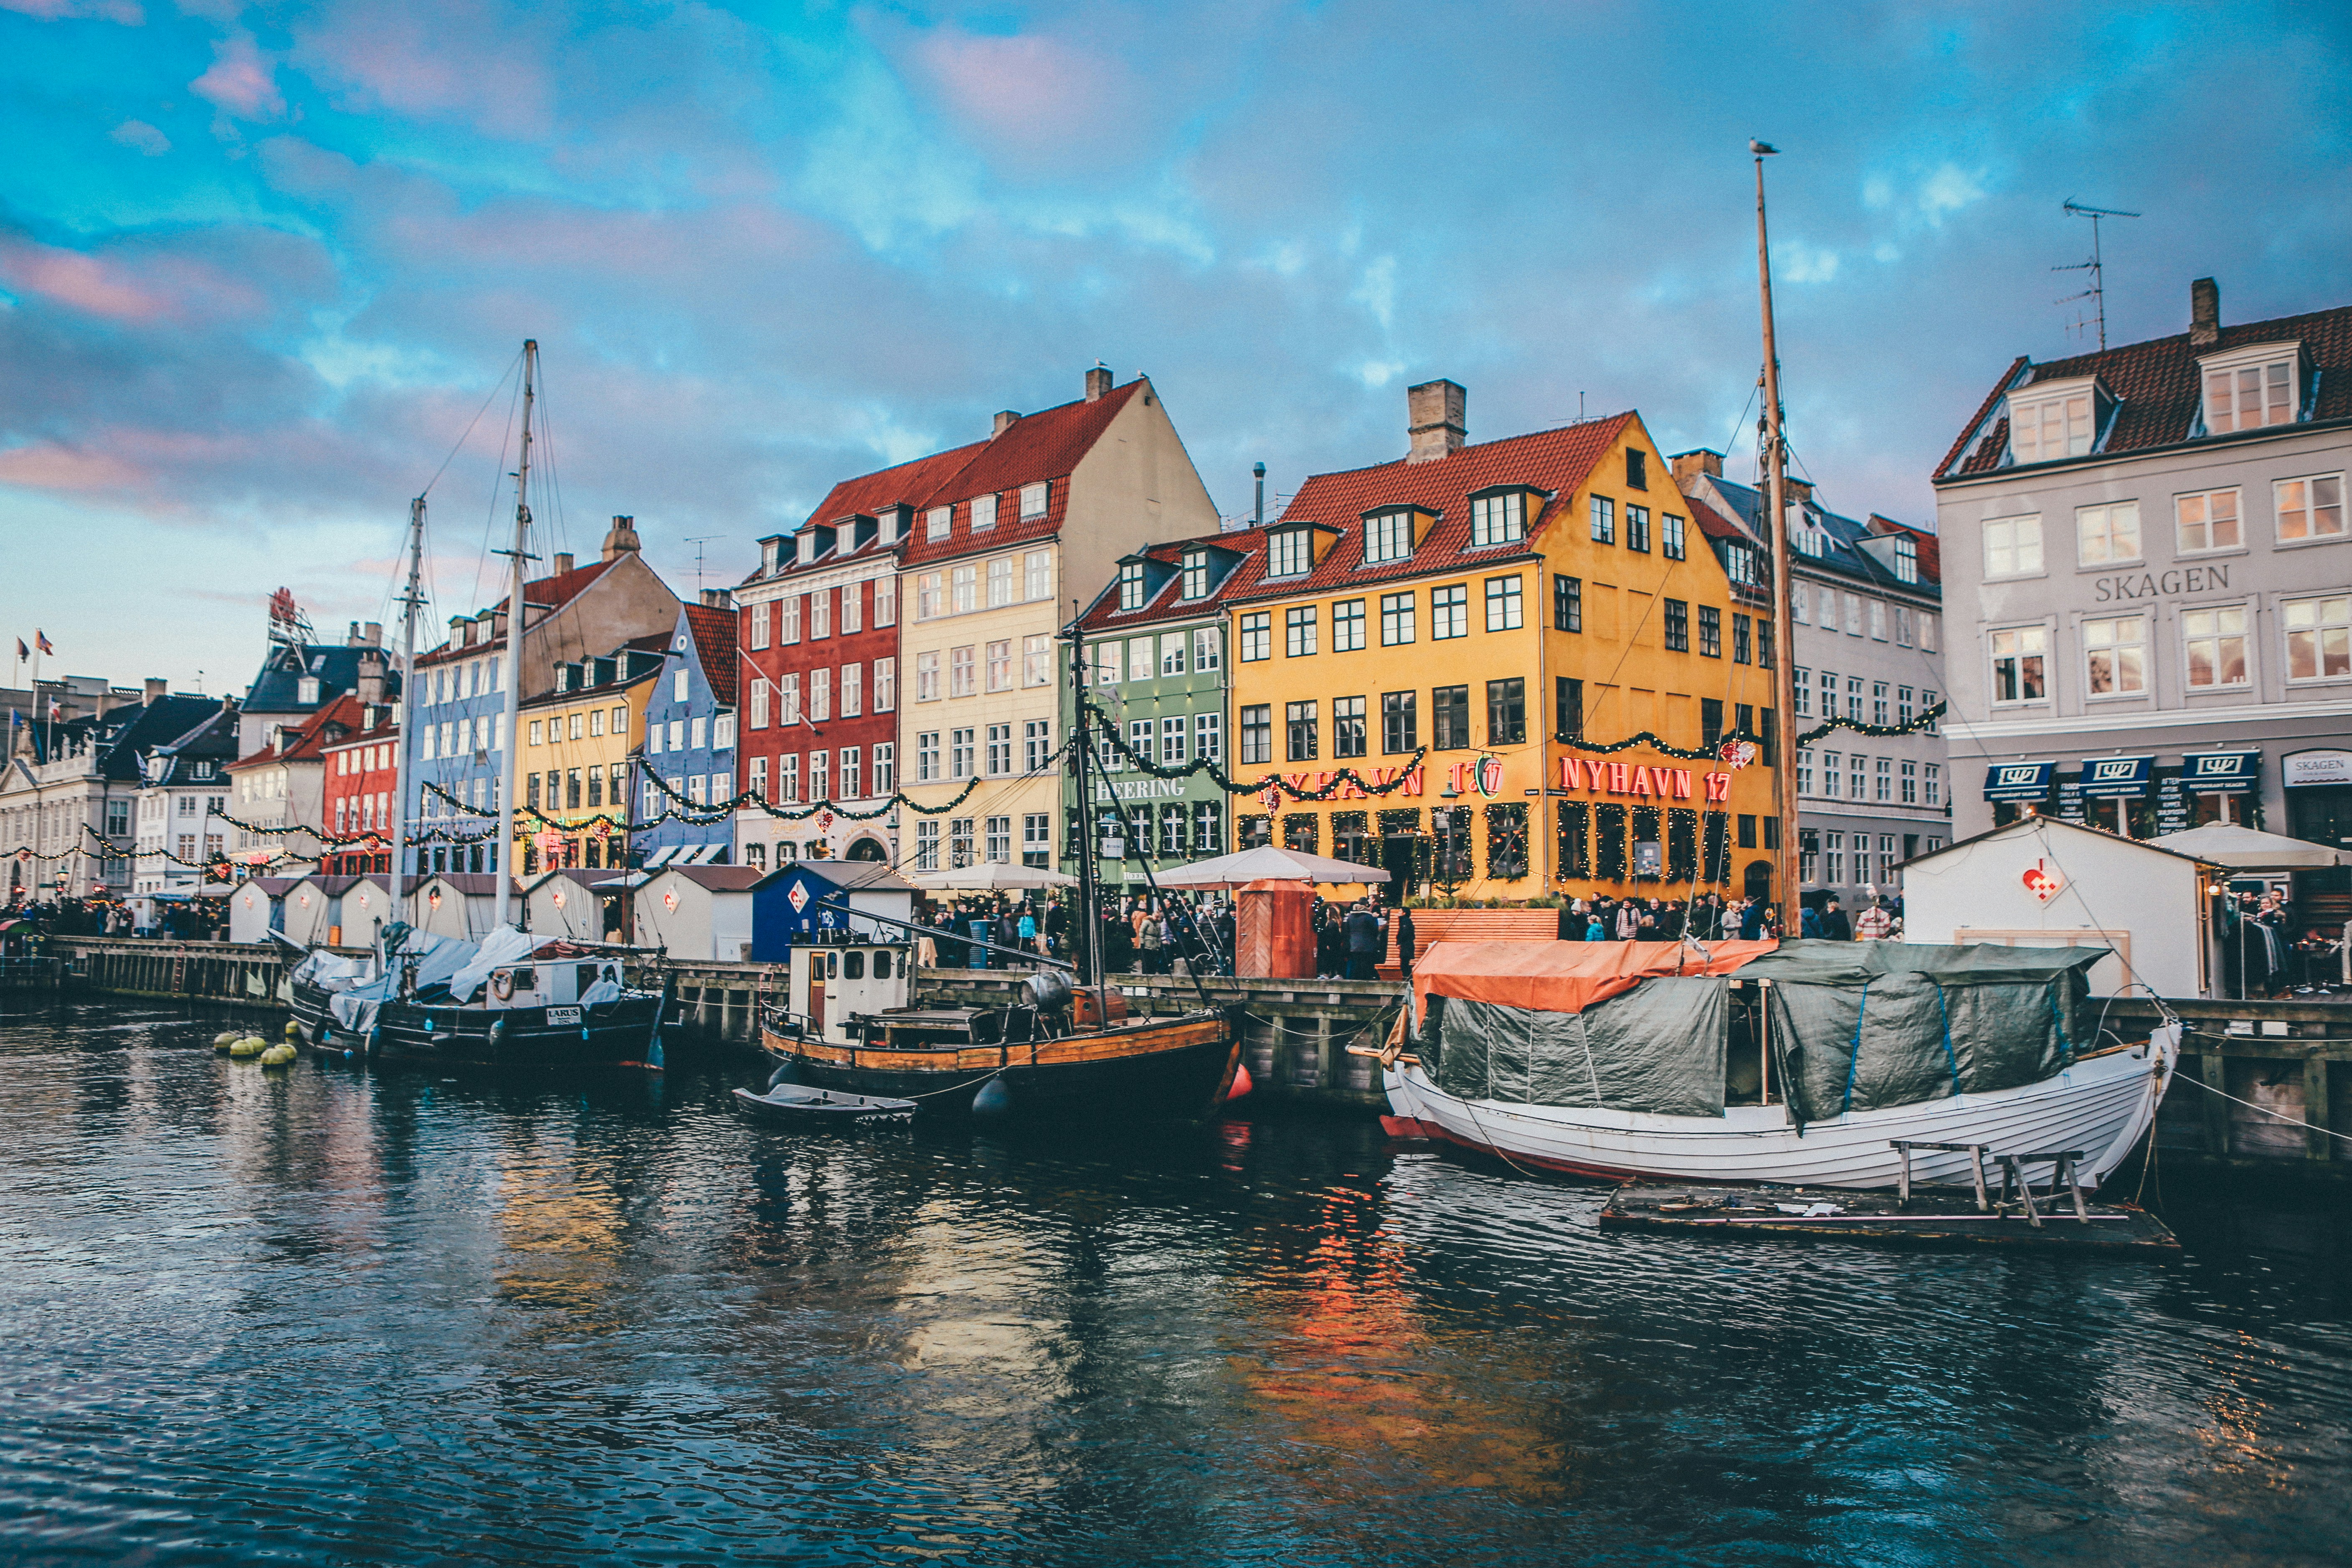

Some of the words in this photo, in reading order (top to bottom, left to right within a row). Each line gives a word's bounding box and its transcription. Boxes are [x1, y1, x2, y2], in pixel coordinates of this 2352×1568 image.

[2096, 564, 2229, 602] SKAGEN
[1485, 763, 1503, 793] 17
[1561, 757, 1692, 798] NYHAVN
[1705, 772, 1731, 801] 17
[2296, 760, 2344, 771] SKAGEN
[1096, 776, 1186, 800] HEERING
[548, 1009, 579, 1017] LARUS
